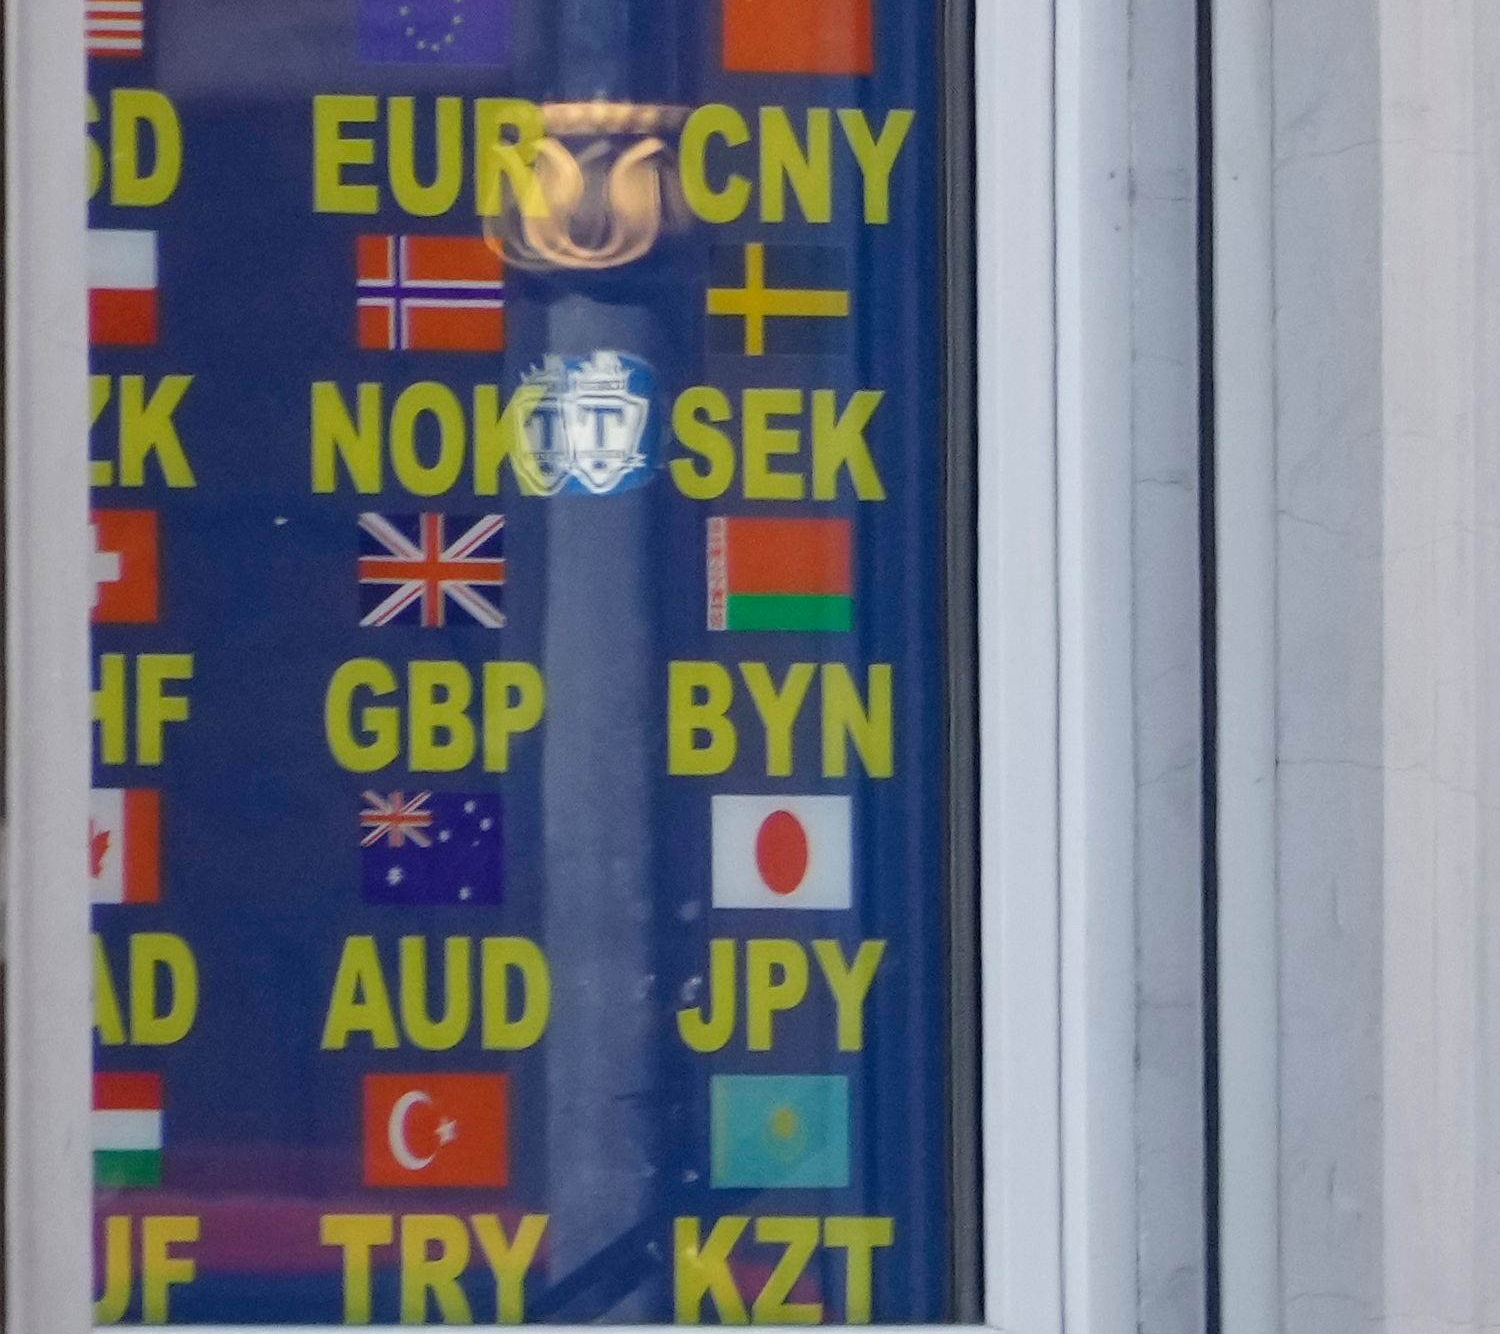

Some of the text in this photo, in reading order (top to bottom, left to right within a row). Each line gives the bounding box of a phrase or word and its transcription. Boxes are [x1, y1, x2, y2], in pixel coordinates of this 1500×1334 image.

[312, 97, 550, 216] EUR
[678, 104, 914, 225] CNY
[311, 381, 545, 497] NOK
[670, 386, 886, 501] SEK
[324, 658, 546, 773] GBP
[667, 662, 894, 779] BYN
[320, 936, 550, 1050] AUD
[677, 939, 885, 1053] JPY
[320, 1213, 548, 1324] TRY
[672, 1216, 894, 1325] KZT
